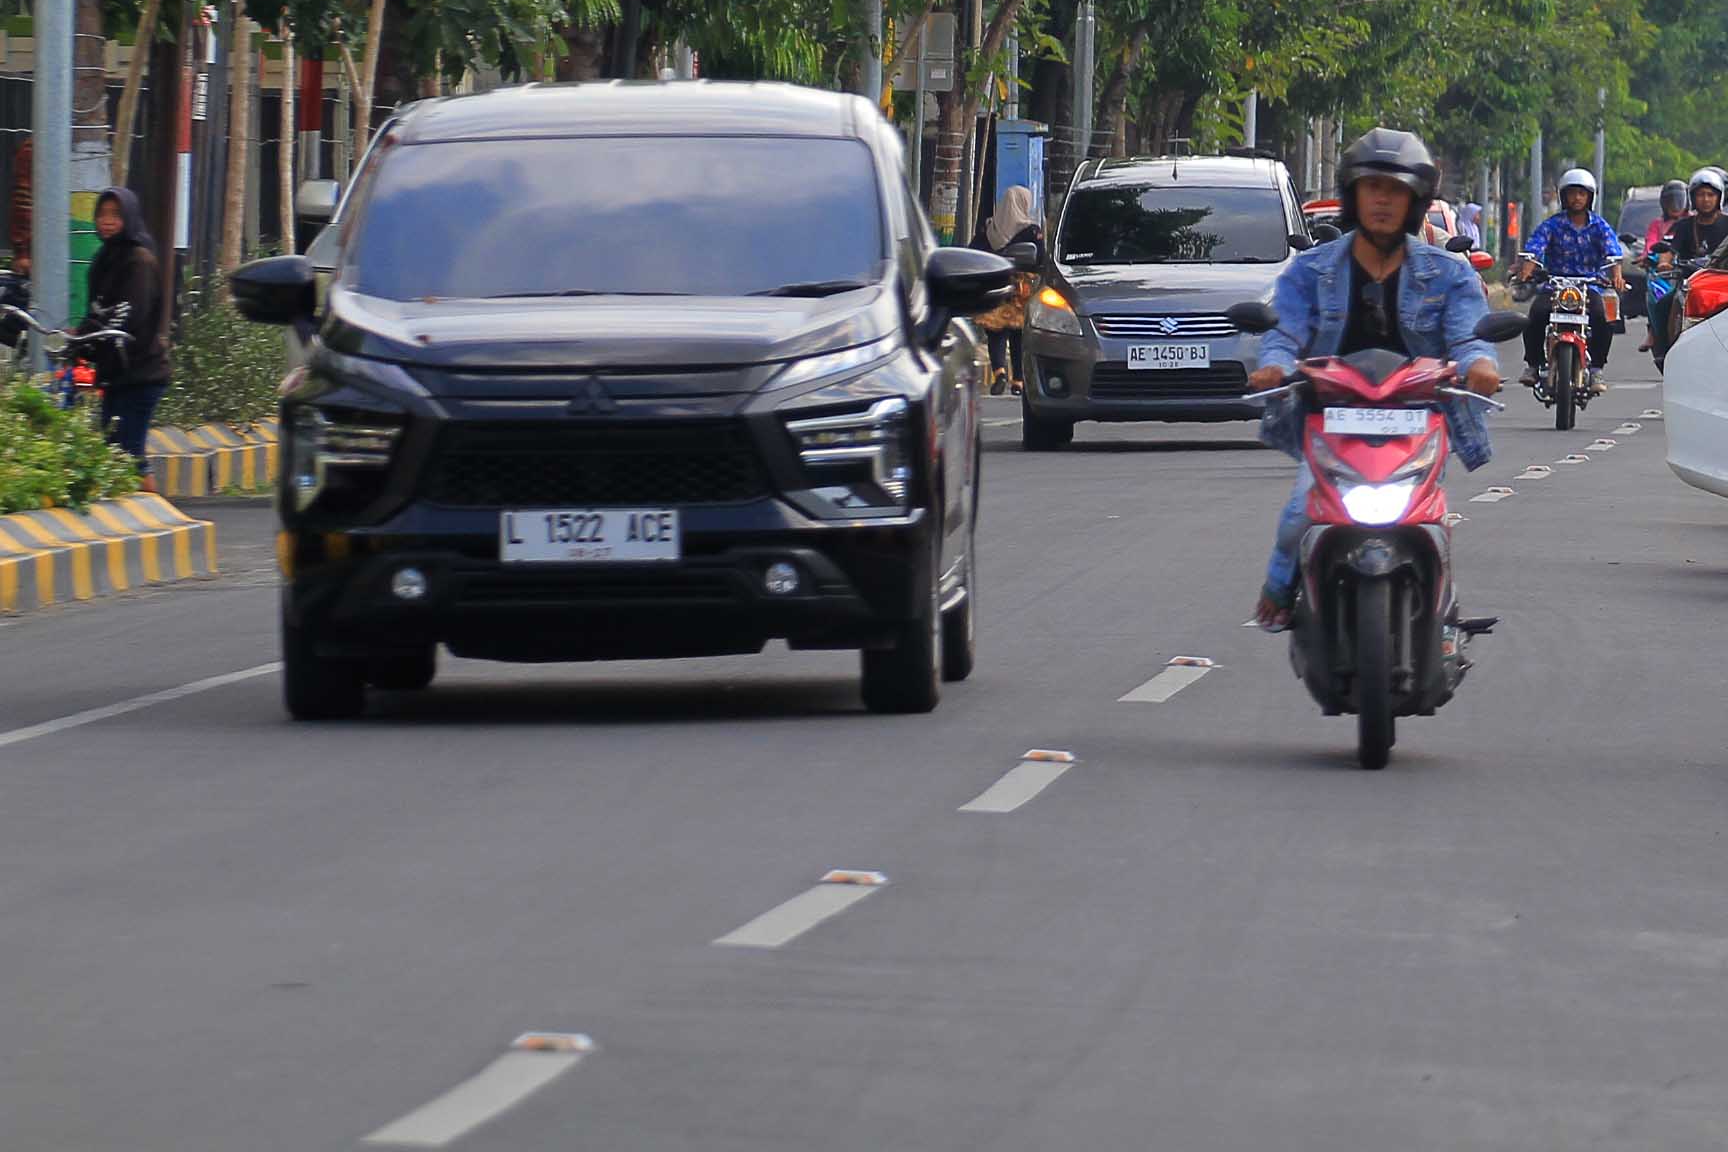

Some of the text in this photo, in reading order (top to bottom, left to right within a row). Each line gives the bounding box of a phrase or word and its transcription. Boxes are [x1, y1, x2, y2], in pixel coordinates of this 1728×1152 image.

[1130, 346, 1206, 361] AE 1450 BJ
[1325, 409, 1345, 421] AE
[1354, 410, 1395, 421] 5554
[507, 513, 673, 544] L 1522 ACE
